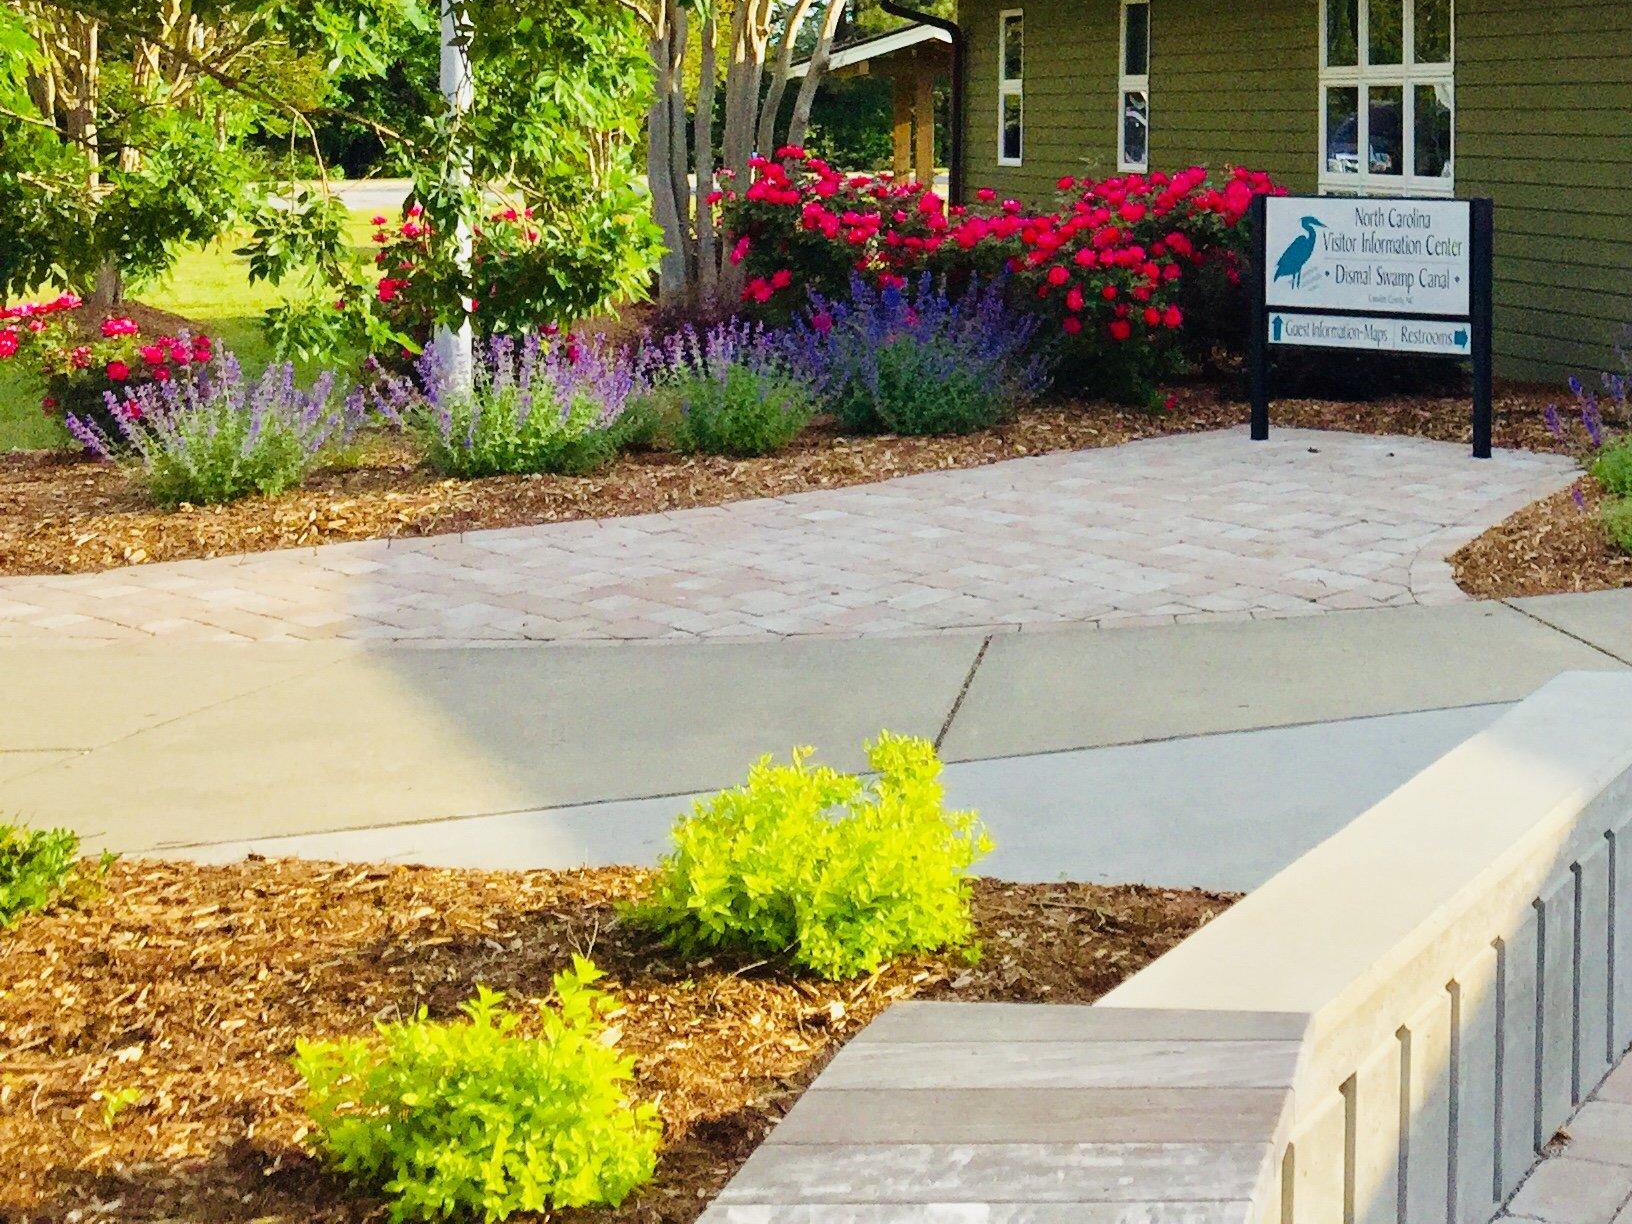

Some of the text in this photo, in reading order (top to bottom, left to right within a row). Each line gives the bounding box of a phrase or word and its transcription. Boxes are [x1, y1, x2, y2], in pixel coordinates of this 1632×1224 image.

[1355, 207, 1431, 229] North Carolina
[1323, 231, 1462, 257] Visitor Information Center
[1335, 264, 1371, 286] Dismal
[1376, 266, 1414, 293] Swamp
[1419, 268, 1450, 289] Canal
[1285, 319, 1310, 337] Guest
[1401, 325, 1452, 345] Restrooms
